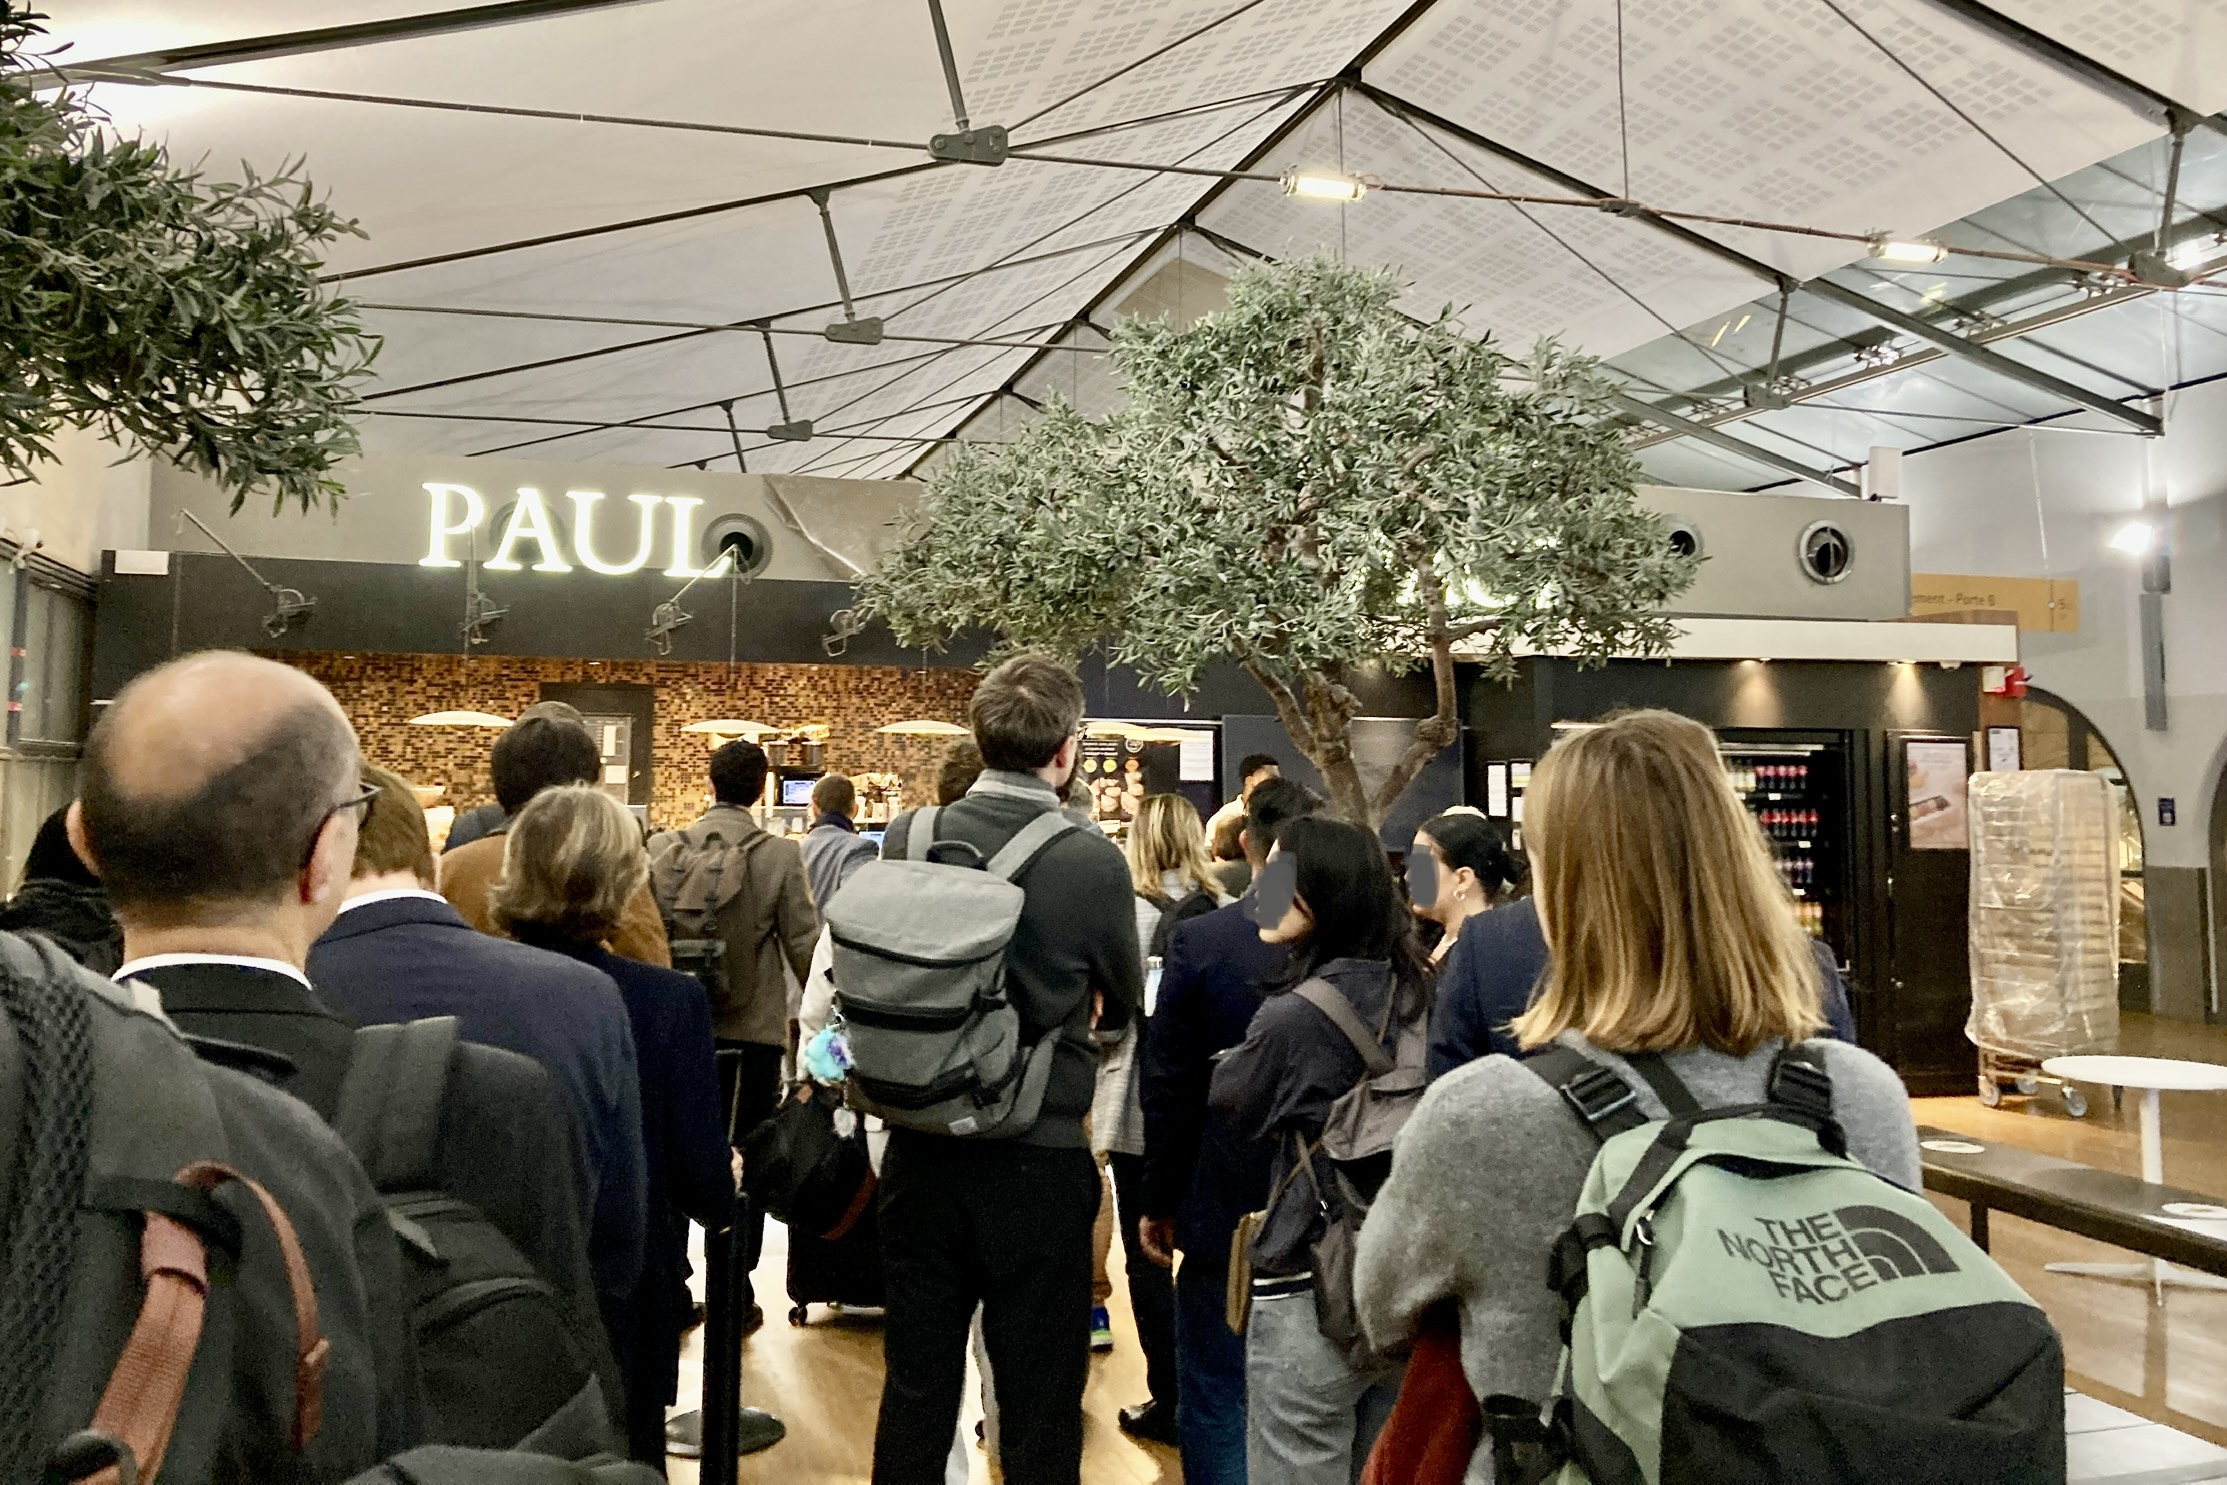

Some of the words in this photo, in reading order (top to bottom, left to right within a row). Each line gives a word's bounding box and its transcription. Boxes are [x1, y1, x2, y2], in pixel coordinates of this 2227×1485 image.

[418, 482, 733, 579] PAUL
[1717, 1228, 1860, 1276] NORTH
[1754, 1212, 1843, 1247] THE
[1768, 1262, 1879, 1305] FACE
